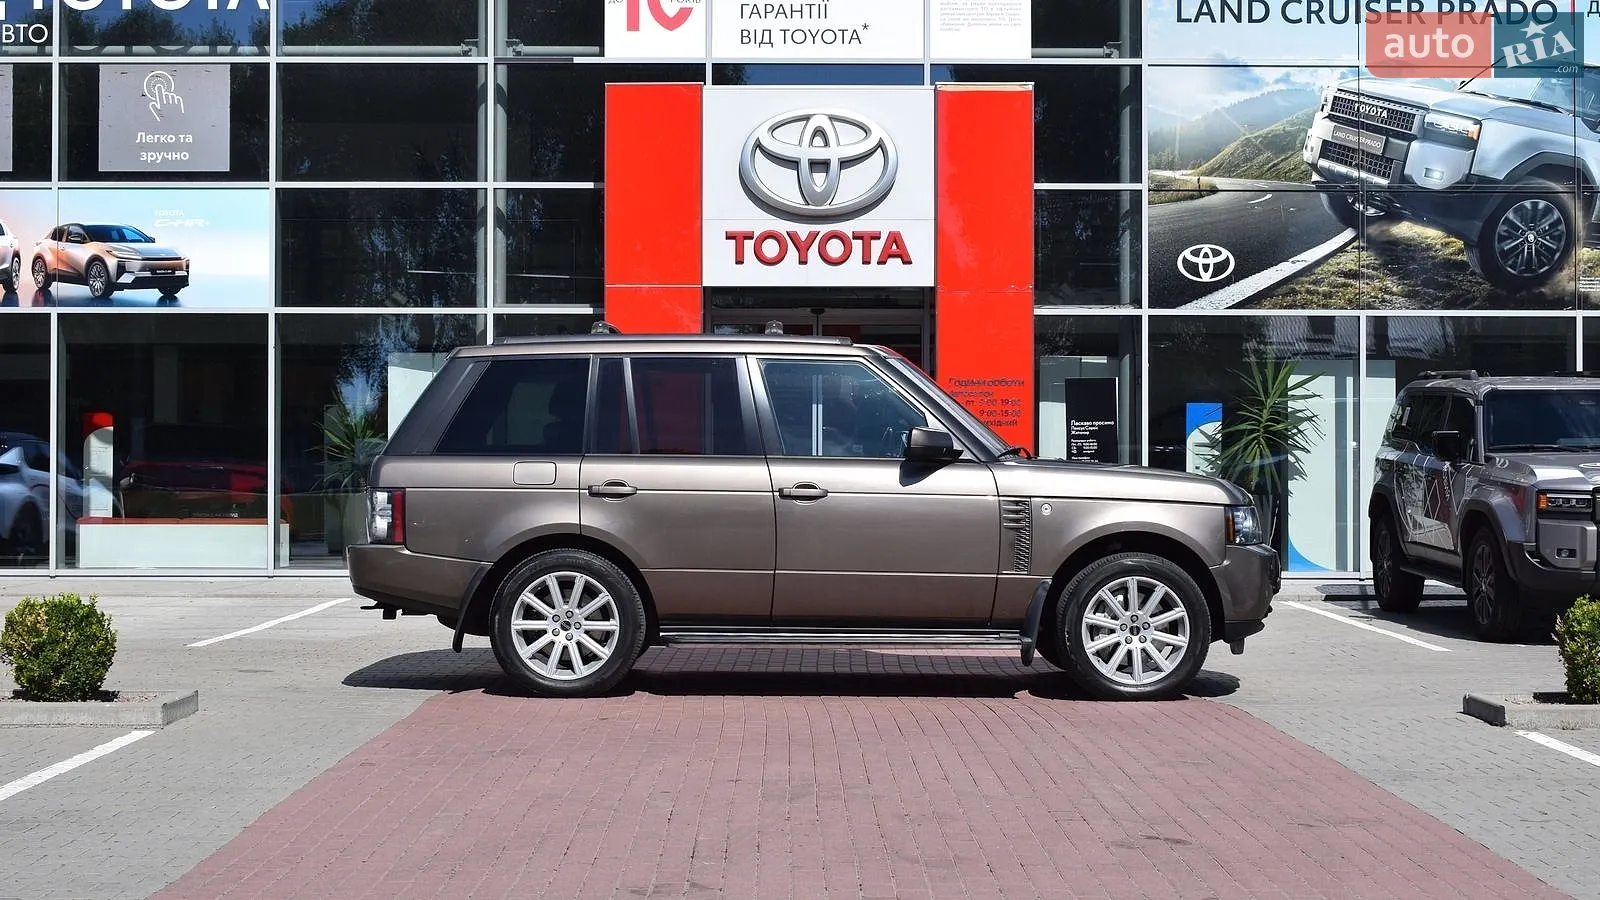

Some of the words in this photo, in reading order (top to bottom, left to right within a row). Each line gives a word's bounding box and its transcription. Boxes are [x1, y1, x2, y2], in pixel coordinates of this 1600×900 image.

[740, 0, 828, 19] ГАРАНТІЇ
[1176, 0, 1270, 24] LAND
[1281, 0, 1426, 25] CRUISER
[1437, 0, 1558, 25] PRADO
[740, 29, 773, 48] ВІД
[1354, 103, 1388, 119] TOYOTA
[135, 132, 176, 143] Легко
[178, 134, 193, 143] та
[140, 152, 190, 163] зручно
[725, 230, 913, 267] TOYOTA
